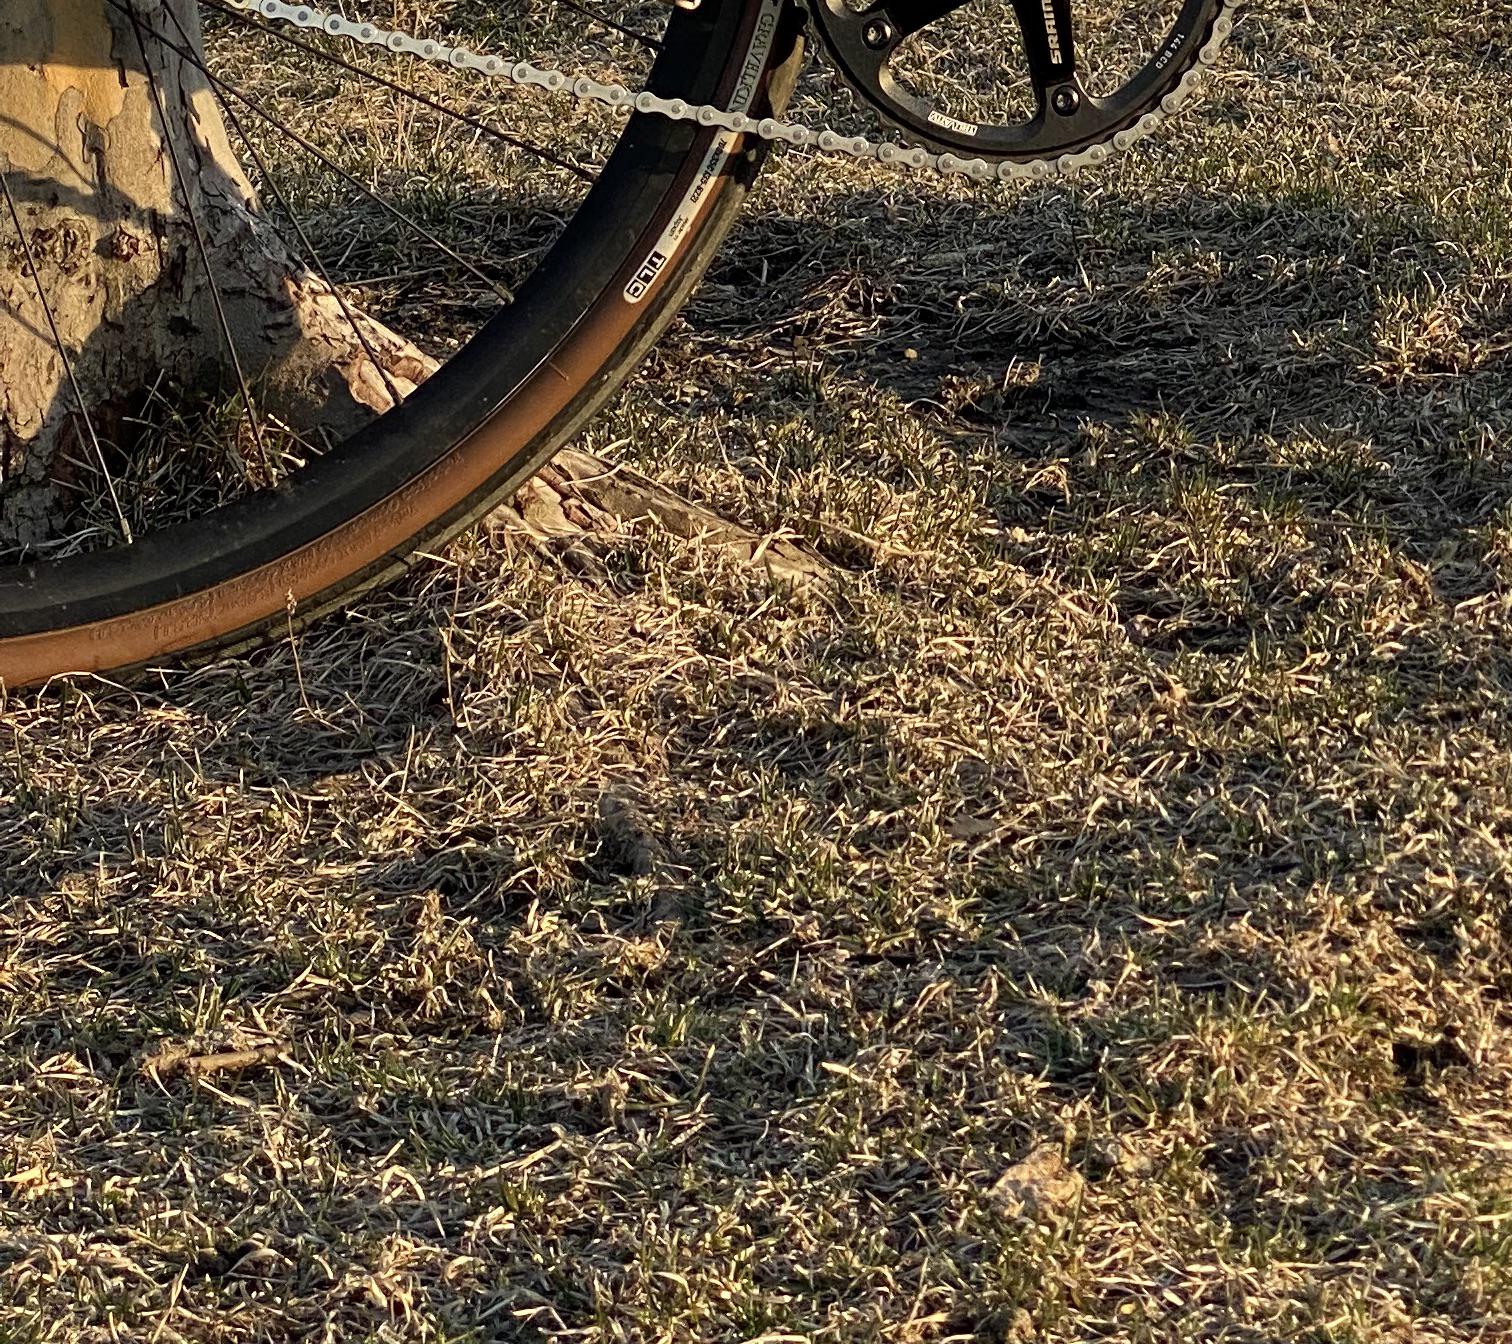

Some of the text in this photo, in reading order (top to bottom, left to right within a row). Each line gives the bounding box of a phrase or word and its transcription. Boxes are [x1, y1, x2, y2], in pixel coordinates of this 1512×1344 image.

[729, 13, 775, 112] GRAVELKIN
[1155, 33, 1185, 69] 144 BCD
[625, 251, 666, 299] TLC
